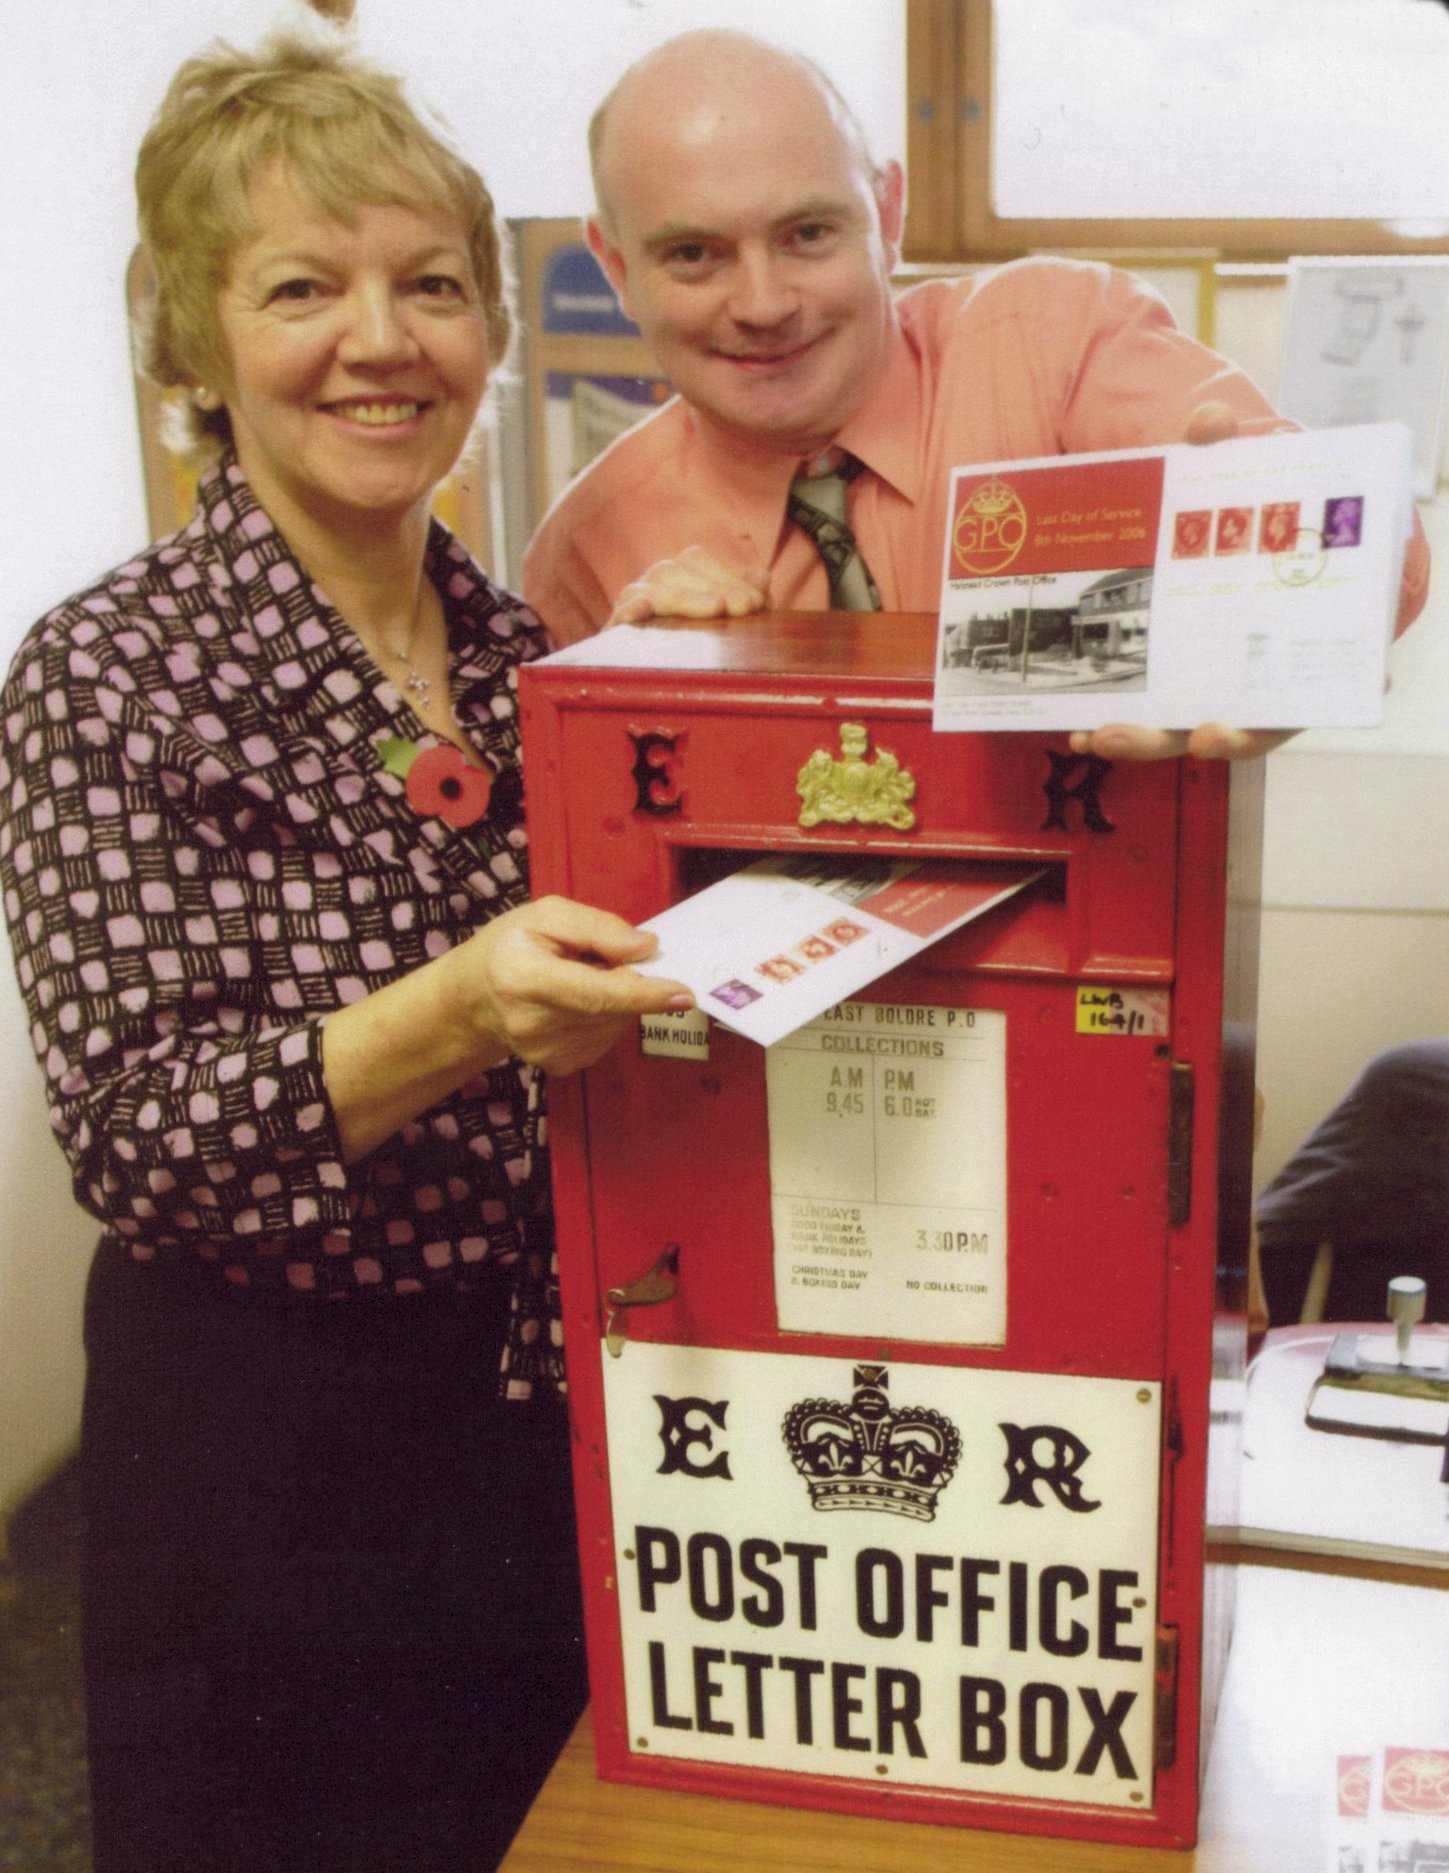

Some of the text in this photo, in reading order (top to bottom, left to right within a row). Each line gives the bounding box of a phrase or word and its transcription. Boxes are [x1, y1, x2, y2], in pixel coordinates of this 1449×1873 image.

[1036, 507, 1142, 526] Last Day of Service
[954, 514, 1027, 552] GPO
[1055, 531, 1113, 544] November
[625, 724, 688, 818] E
[821, 1034, 945, 1057] COLLECTIONS
[826, 1092, 865, 1115] 9.45
[791, 1204, 861, 1221] SUNDAYS
[791, 1264, 869, 1279] CHRISTMAS DAY
[802, 1277, 838, 1289] BOXING
[841, 1280, 860, 1290] DAY
[906, 1280, 989, 1294] NO COLLECTION
[652, 1395, 1102, 1513] E R
[635, 1525, 1143, 1663] POST OFFICE
[649, 1641, 1139, 1781] LETTER BOX
